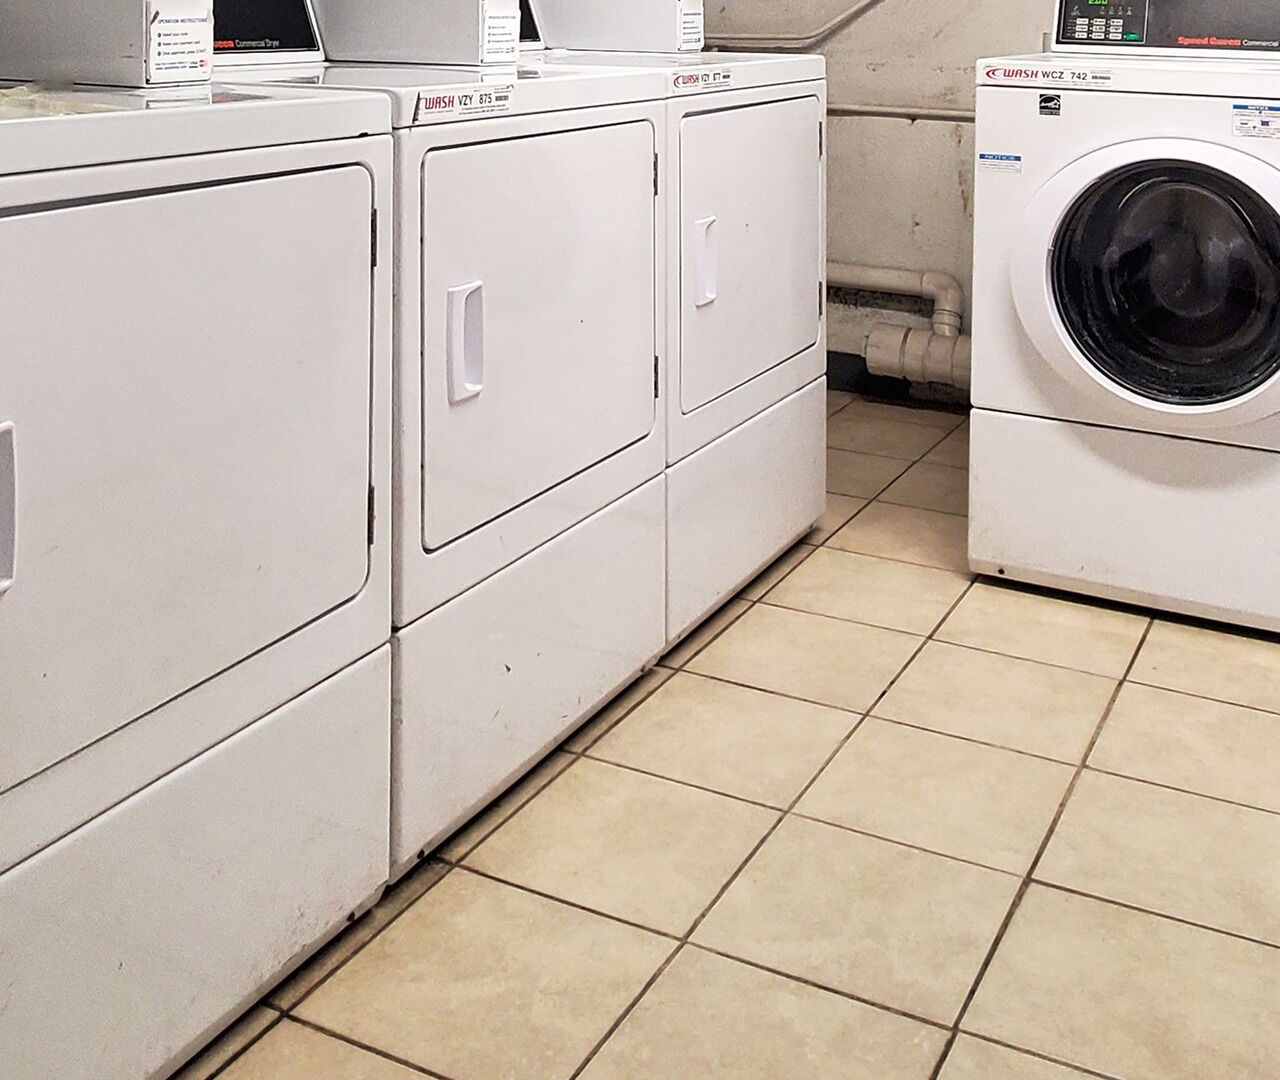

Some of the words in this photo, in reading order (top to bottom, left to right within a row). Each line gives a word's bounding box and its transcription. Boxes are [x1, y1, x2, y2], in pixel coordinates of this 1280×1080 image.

[1003, 68, 1039, 79] WASH
[1041, 70, 1065, 80] WCZ
[1070, 72, 1088, 81] 742
[424, 95, 455, 110] WASH
[457, 94, 474, 106] VZY
[479, 93, 492, 104] 875
